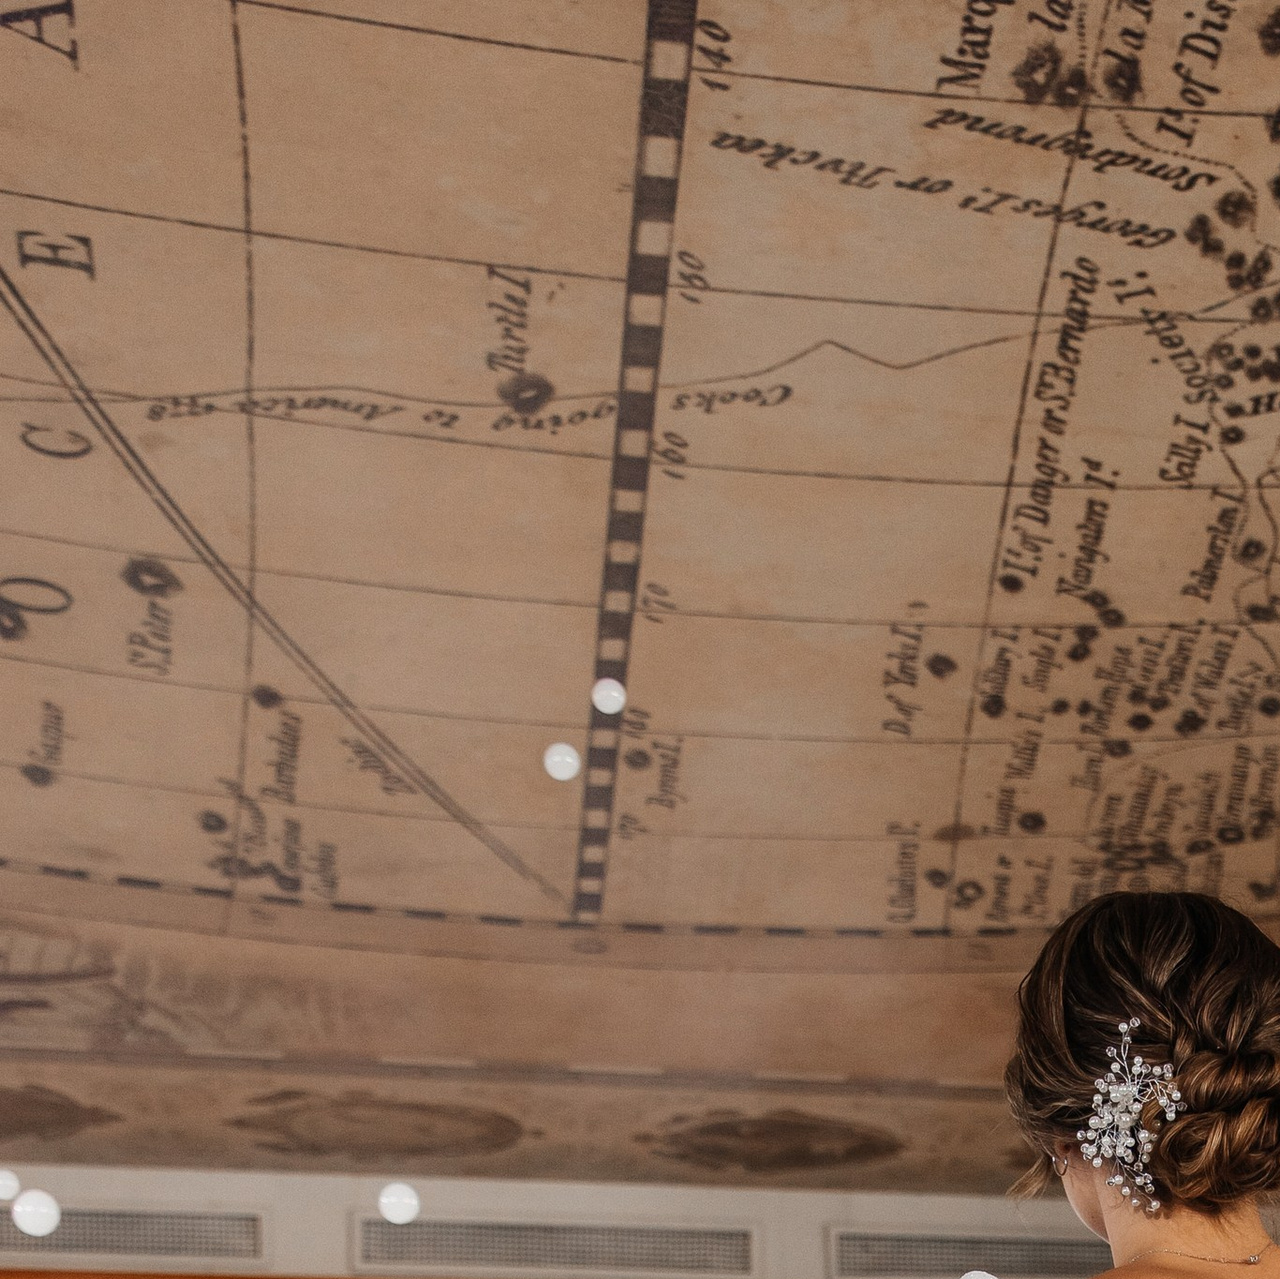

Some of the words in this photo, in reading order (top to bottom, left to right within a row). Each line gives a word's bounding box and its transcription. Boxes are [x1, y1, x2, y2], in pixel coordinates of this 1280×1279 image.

[695, 19, 732, 92] 140
[1173, 62, 1222, 107] of
[895, 176, 954, 200] or
[1012, 197, 1177, 252] Georges
[1013, 435, 1070, 526] Danger
